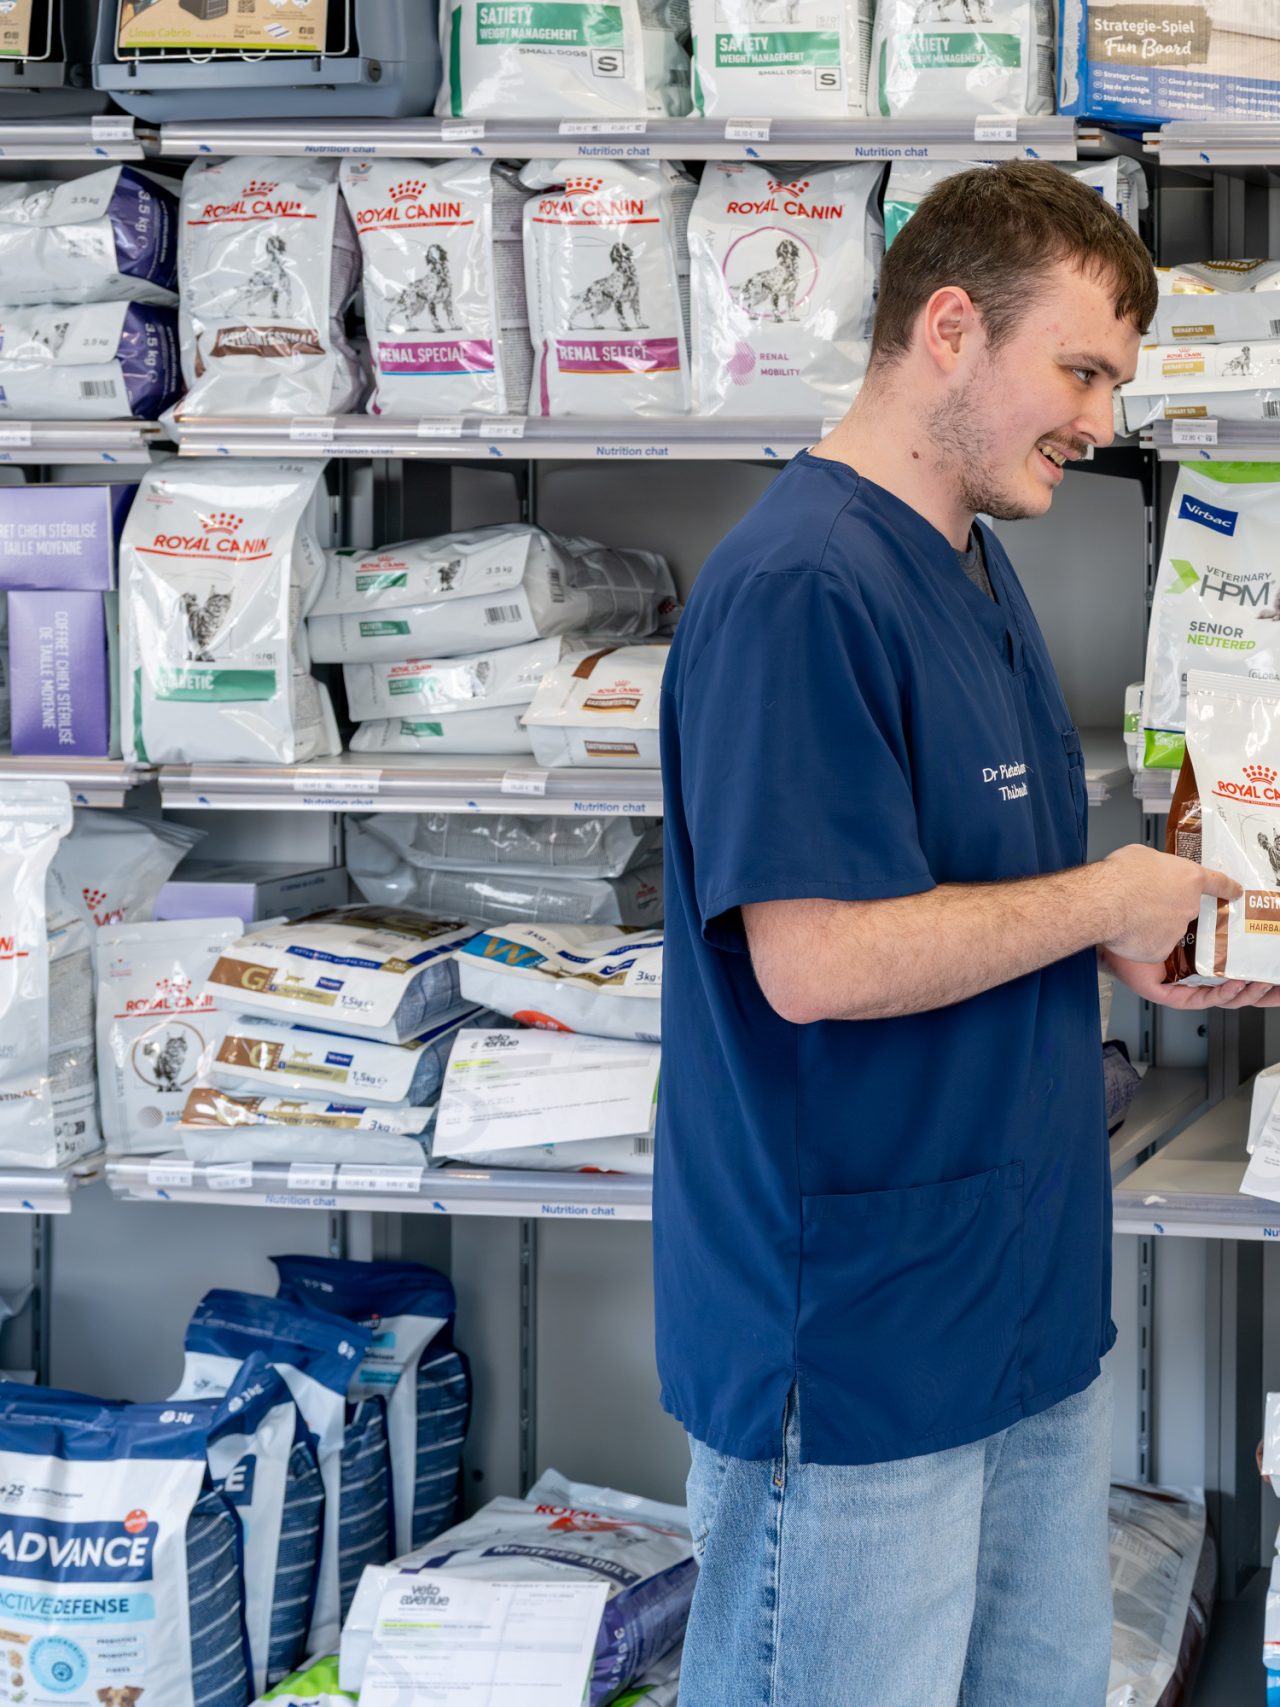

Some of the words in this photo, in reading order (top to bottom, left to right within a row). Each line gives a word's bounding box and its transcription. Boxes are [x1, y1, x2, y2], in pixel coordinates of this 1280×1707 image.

[480, 6, 534, 25] SATIETY
[480, 28, 510, 41] WEIGHT
[511, 28, 578, 41] MANAGEMENT
[1094, 18, 1196, 35] Strategie-Spiel
[719, 37, 769, 52] SATIETY
[1104, 36, 1137, 57] Fun
[1142, 36, 1192, 58] Board
[751, 52, 805, 64] MANAGEMENT
[578, 145, 623, 156] Nutrition
[626, 145, 650, 156] chat
[855, 147, 902, 157] Nutrition
[904, 147, 928, 157] chat
[357, 205, 400, 224] ROYAL
[408, 202, 461, 219] CANIN
[539, 200, 574, 216] ROYAL
[581, 200, 645, 216] CANIN
[726, 198, 778, 215] ROYAL
[783, 201, 844, 219] CANIN
[381, 347, 416, 363] RENAL
[418, 346, 466, 362] SPECIAL
[560, 346, 599, 361] RENAL
[602, 345, 649, 360] SELECT
[760, 353, 789, 361] RENAL
[760, 368, 801, 376] MOBILITY
[596, 446, 642, 456] Nutrition
[644, 446, 668, 456] chat
[1185, 502, 1232, 528] Virbac
[18, 523, 47, 538] CHIEN
[36, 541, 83, 555] MOYENNE
[154, 534, 211, 551] ROYAL
[216, 538, 269, 552] CANIN
[1206, 565, 1272, 582] VETERINARY
[1200, 575, 1270, 606] HPM
[1189, 621, 1243, 638] SENIOR
[1187, 634, 1256, 650] NEUTERED
[982, 768, 998, 783] Dr
[1217, 780, 1257, 799] ROYAL
[574, 802, 617, 812] Nutrition
[620, 802, 646, 812] chat
[265, 1194, 310, 1206] Nutrition
[313, 1196, 337, 1206] chat
[542, 1205, 588, 1216] Nutrition
[591, 1206, 615, 1216] chat
[0, 1529, 150, 1567] ADVANCE
[580, 1557, 635, 1580] ADULT
[412, 1583, 440, 1595] veto
[53, 1598, 130, 1614] DEFENSE
[399, 1594, 450, 1606] avenue
